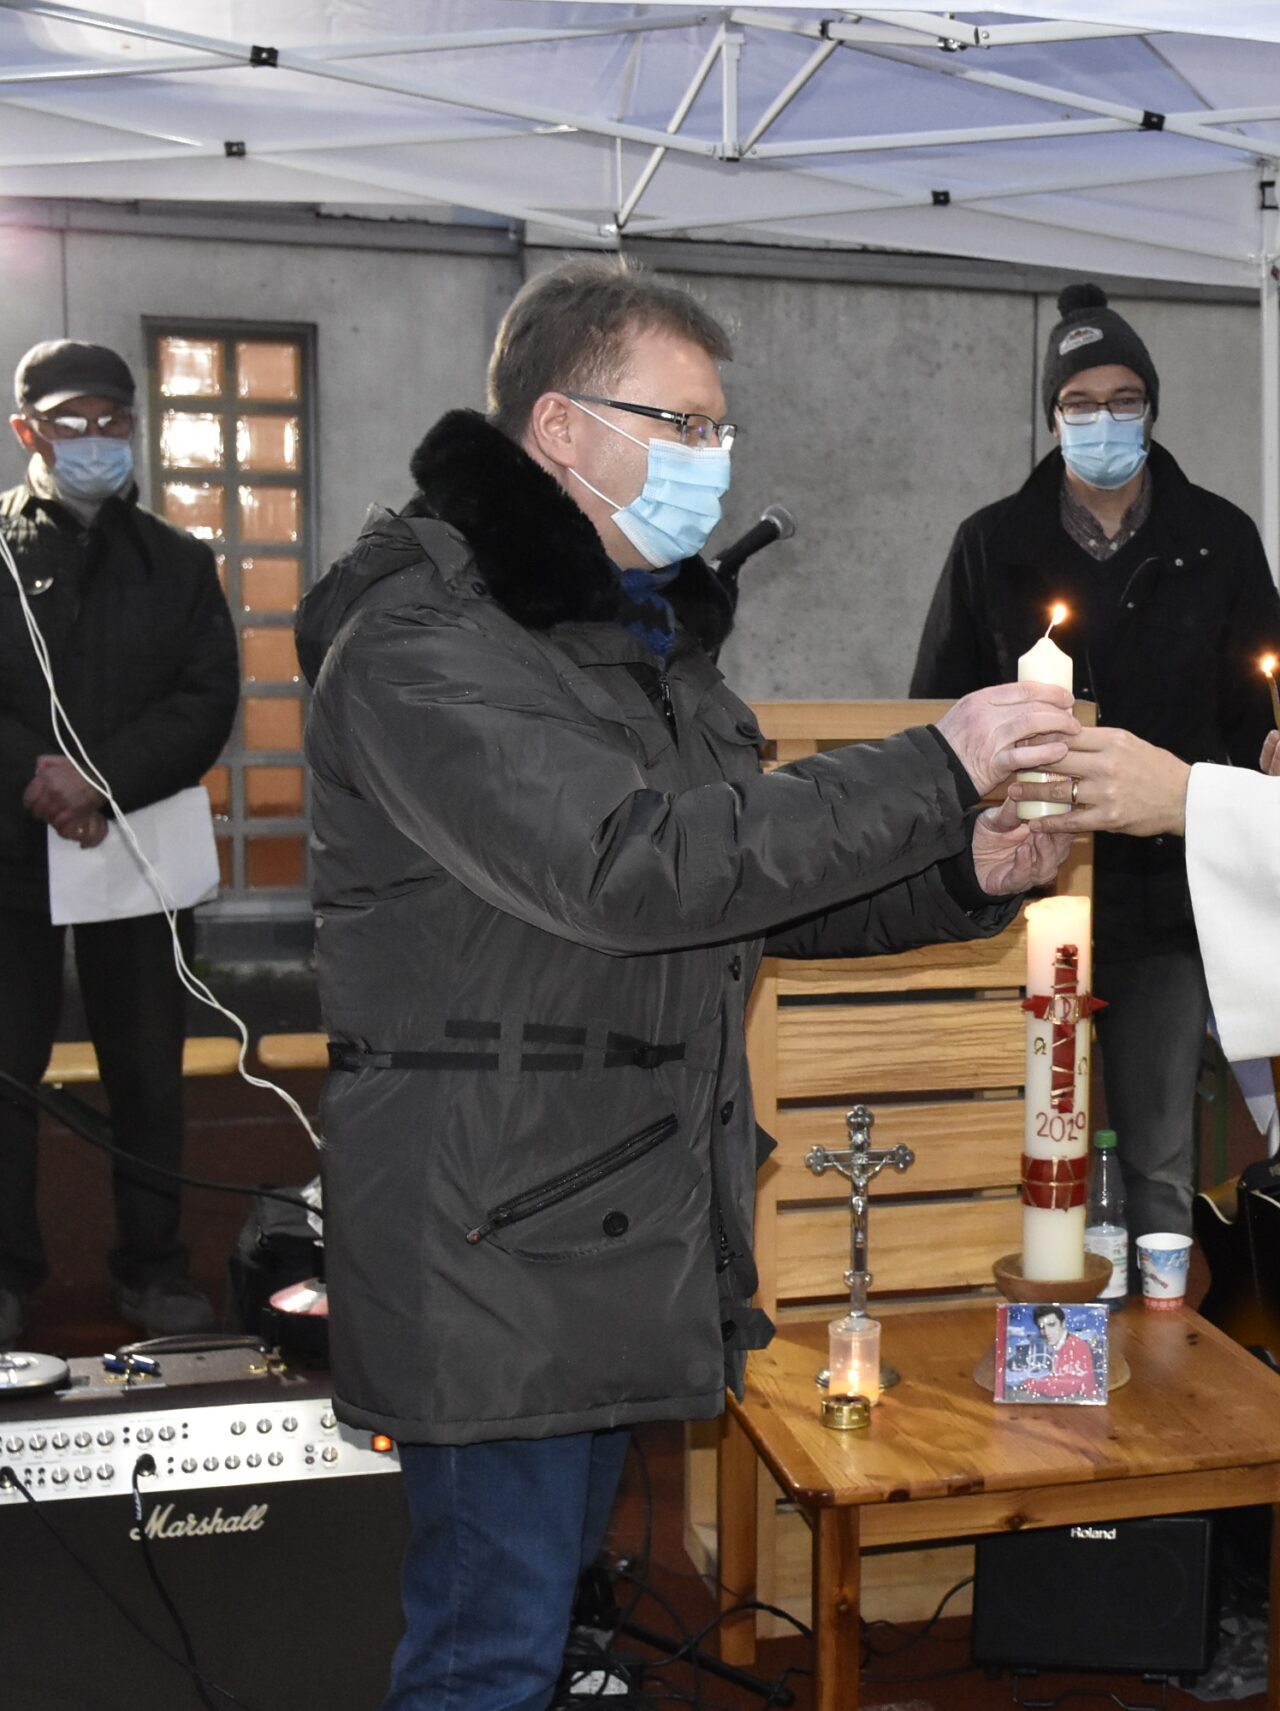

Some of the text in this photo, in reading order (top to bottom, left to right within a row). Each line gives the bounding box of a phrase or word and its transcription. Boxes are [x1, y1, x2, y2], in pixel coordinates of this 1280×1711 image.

[1035, 1111, 1086, 1142] 2020
[129, 1503, 269, 1541] Marshall
[1071, 1527, 1117, 1540] Roland
